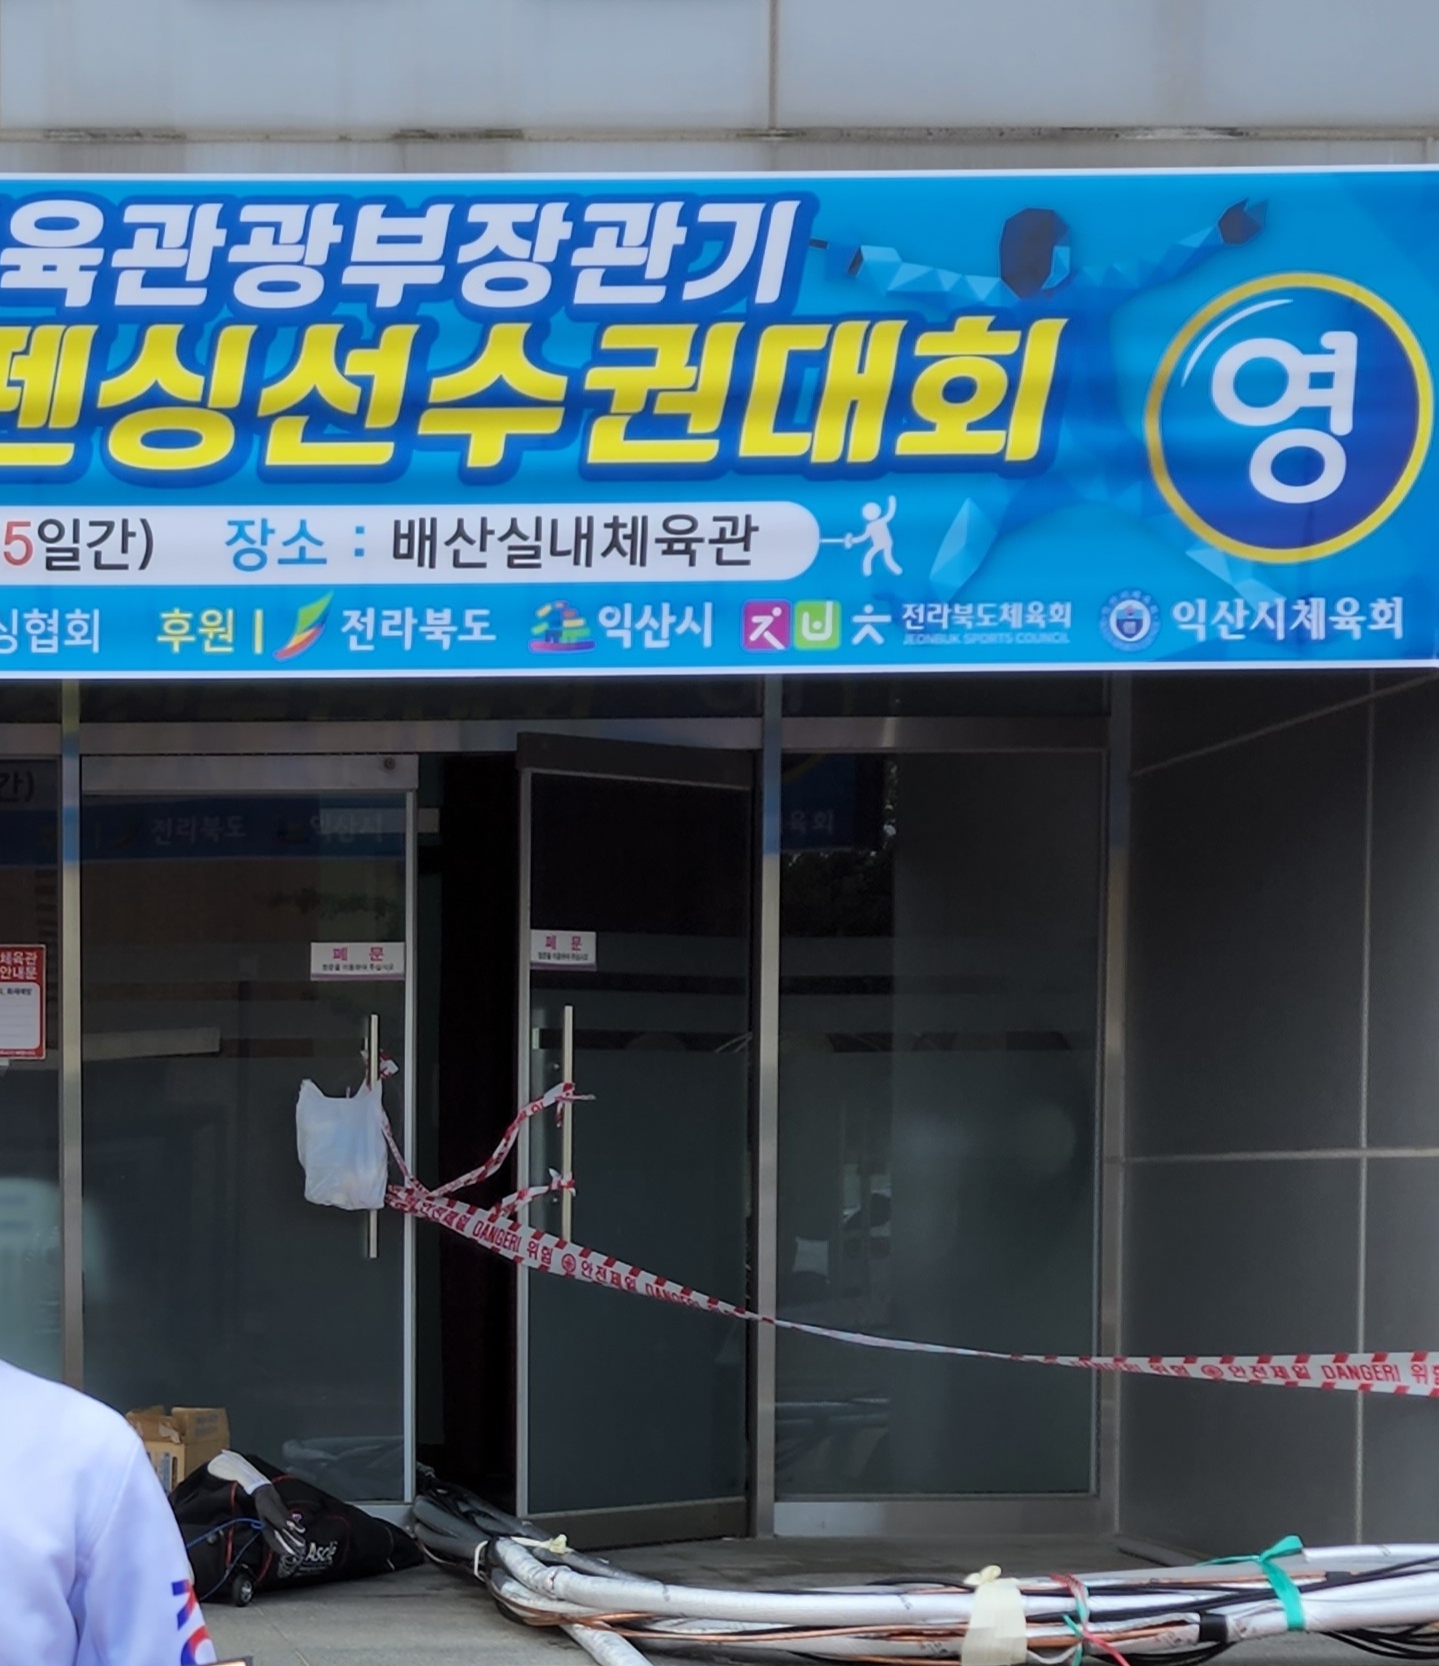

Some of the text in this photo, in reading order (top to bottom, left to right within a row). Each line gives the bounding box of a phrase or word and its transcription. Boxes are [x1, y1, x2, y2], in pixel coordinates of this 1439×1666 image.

[1210, 330, 1359, 505] 영
[224, 516, 328, 573] 장소
[392, 513, 760, 570] 배산실내체육관
[156, 607, 236, 654] 후원
[340, 600, 497, 652] 전라북도
[597, 599, 714, 650] 익산시
[901, 600, 1073, 630] 전라북도체육회
[1171, 596, 1405, 642] 익산시체육회
